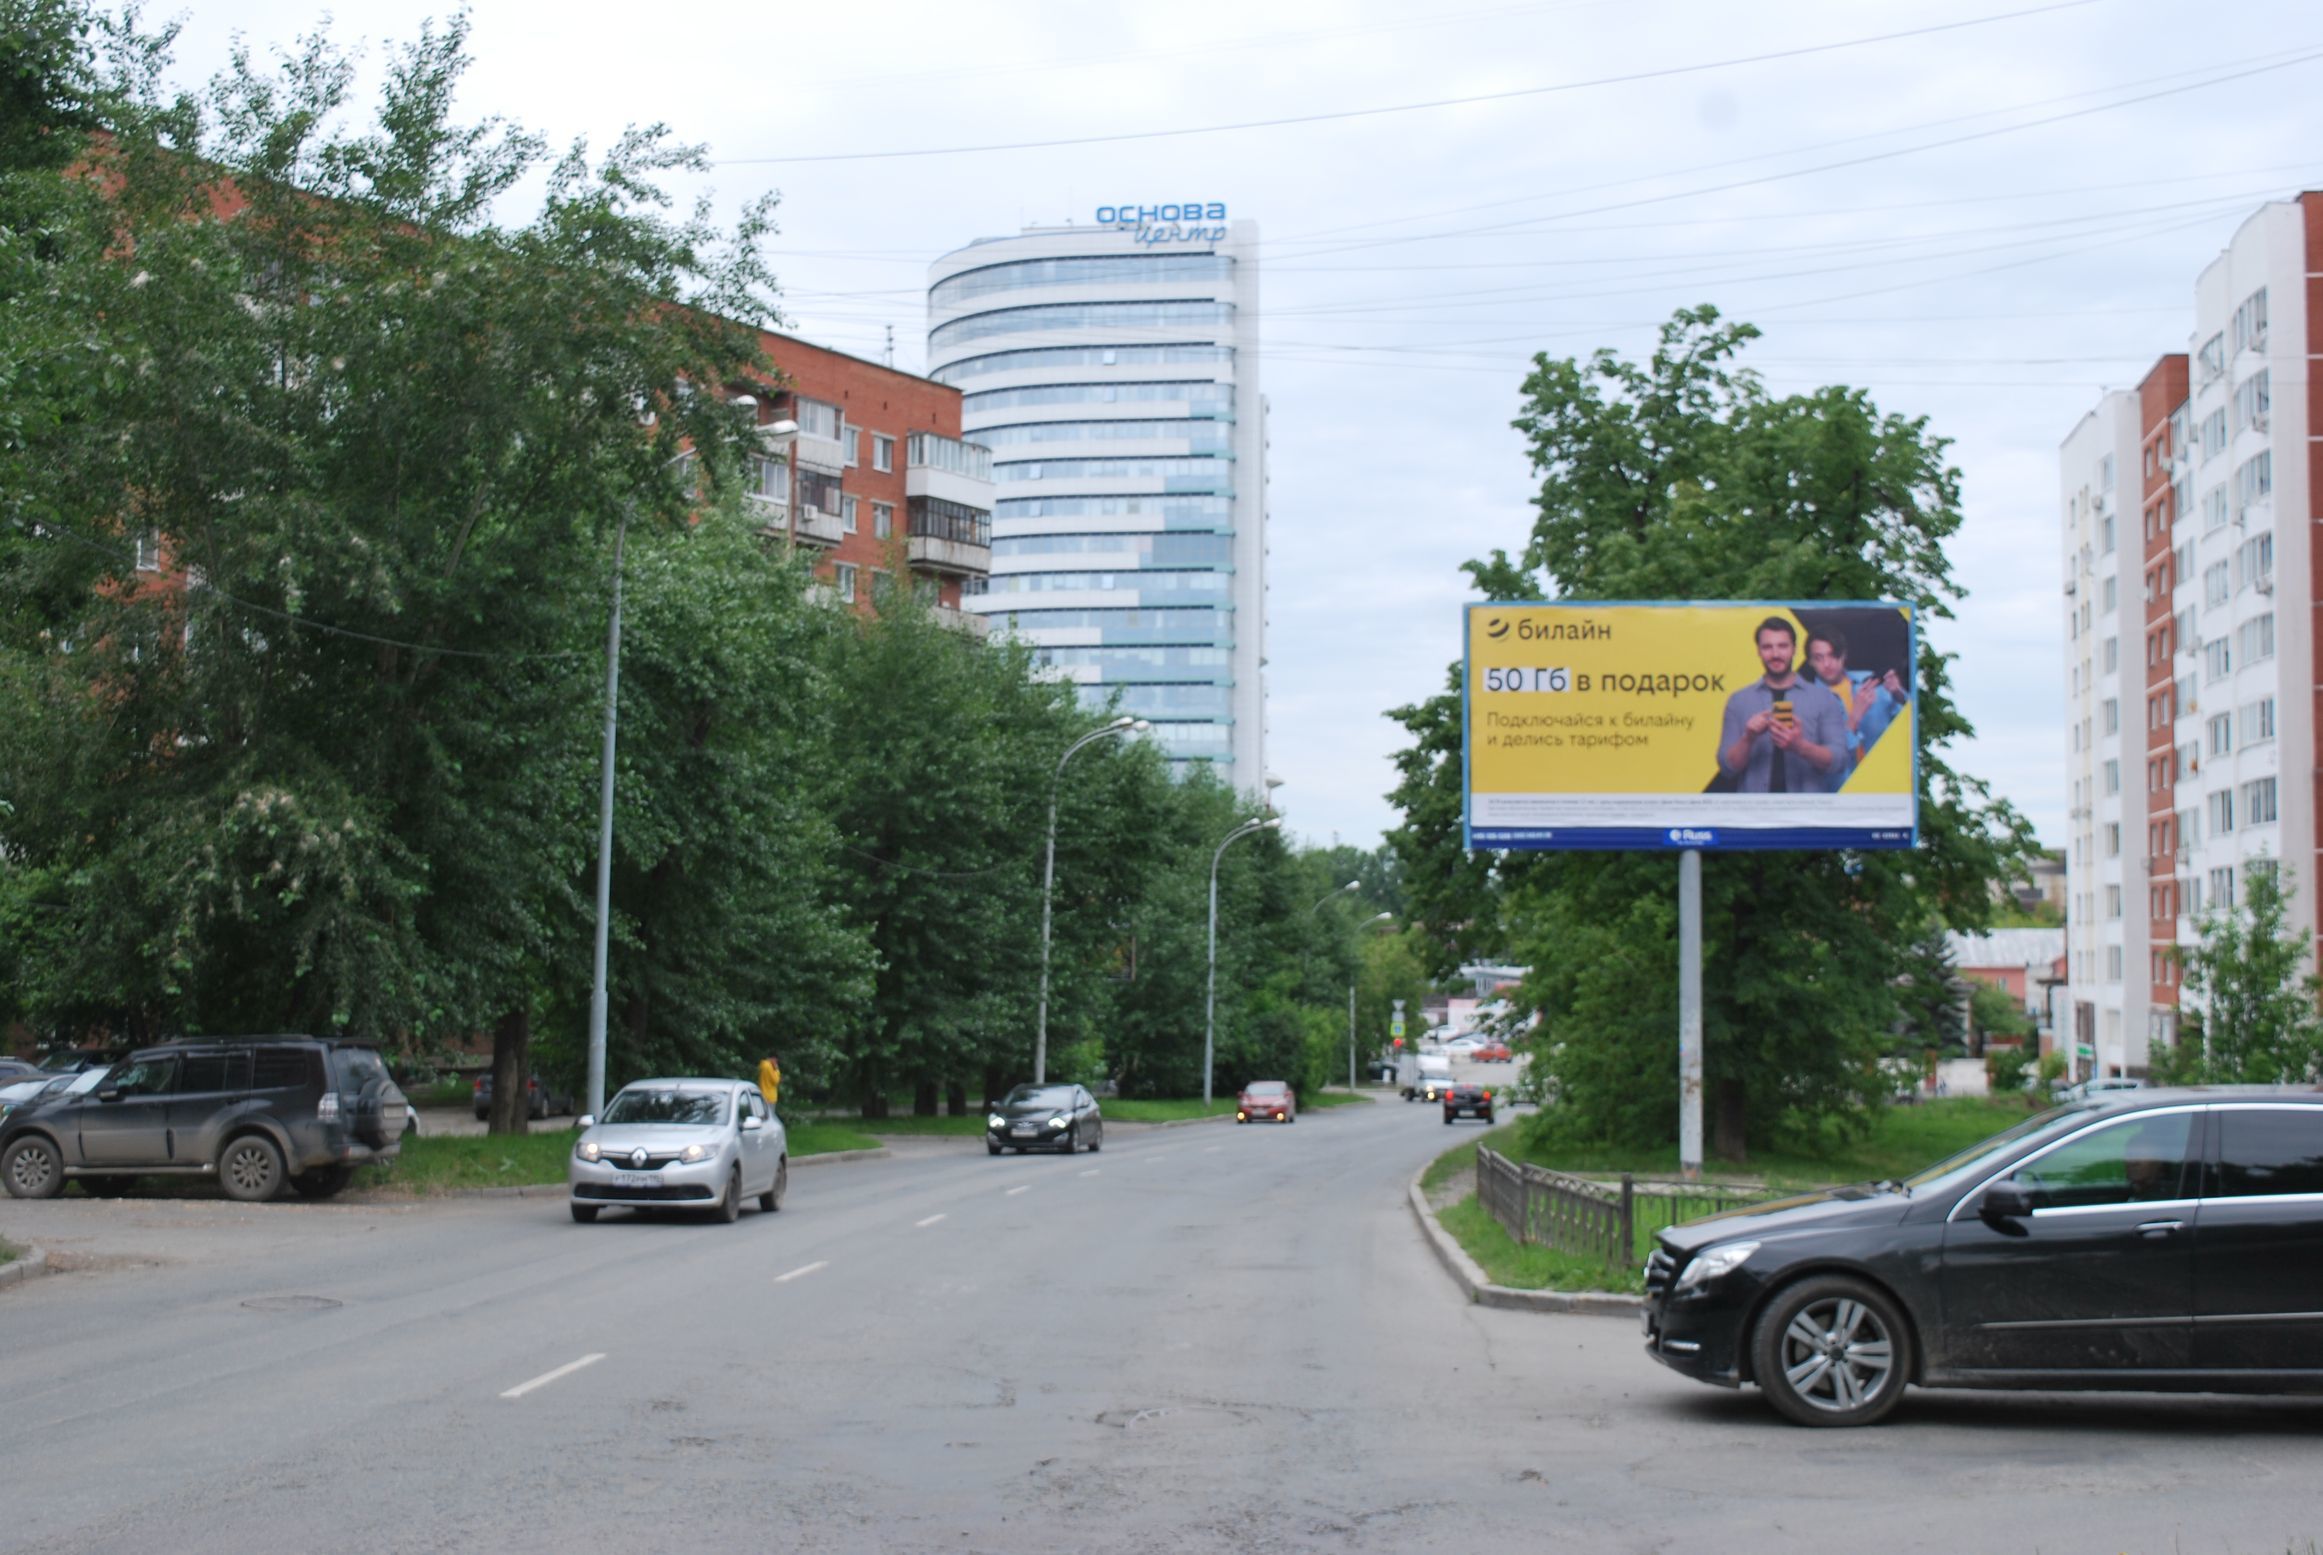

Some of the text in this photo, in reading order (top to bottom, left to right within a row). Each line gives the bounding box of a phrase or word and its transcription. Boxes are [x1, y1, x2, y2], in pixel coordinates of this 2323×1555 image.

[1518, 618, 1611, 640] билайн
[1487, 667, 1725, 697] 50 Гб в подарок
[1487, 711, 1695, 730] Подключайся к билайну
[1487, 732, 1649, 748] и делись тарифом
